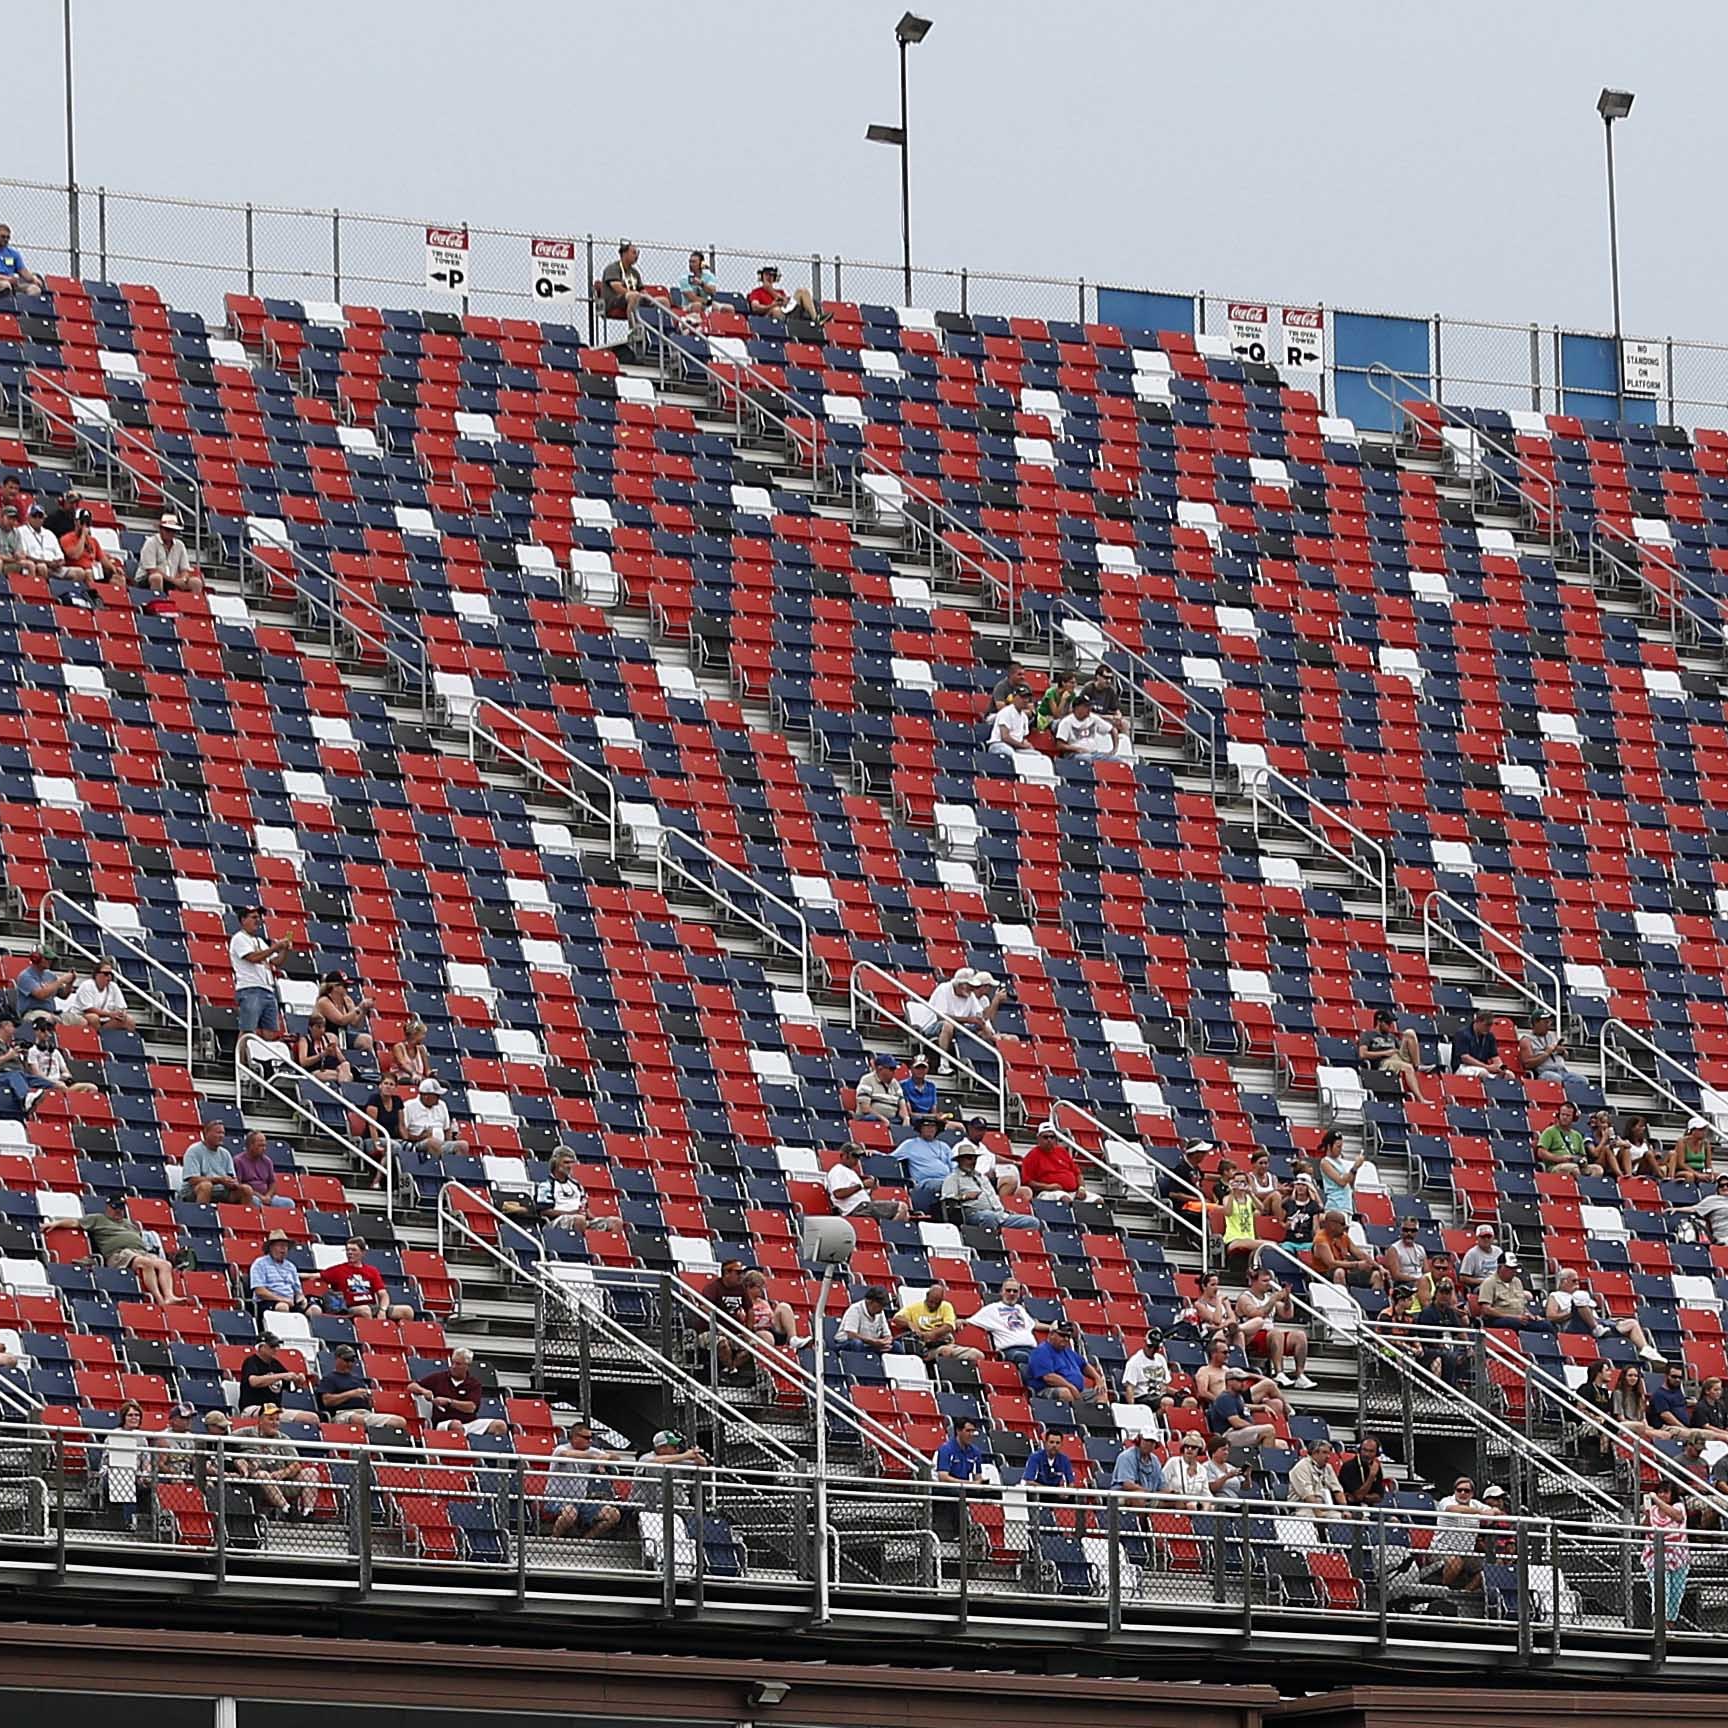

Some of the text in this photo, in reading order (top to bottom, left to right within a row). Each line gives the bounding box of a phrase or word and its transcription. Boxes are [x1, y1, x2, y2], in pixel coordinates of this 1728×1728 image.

[435, 258, 460, 266] TOWER
[541, 269, 566, 277] TOWER
[449, 269, 464, 288] P
[535, 278, 553, 298] Q
[1236, 331, 1260, 339] TOWER
[1291, 337, 1315, 345] TOWER
[1249, 343, 1266, 362] Q
[1637, 344, 1648, 354] NO
[1287, 347, 1302, 366] R
[1626, 356, 1660, 366] STANDING
[1626, 380, 1661, 389] PLATFORM
